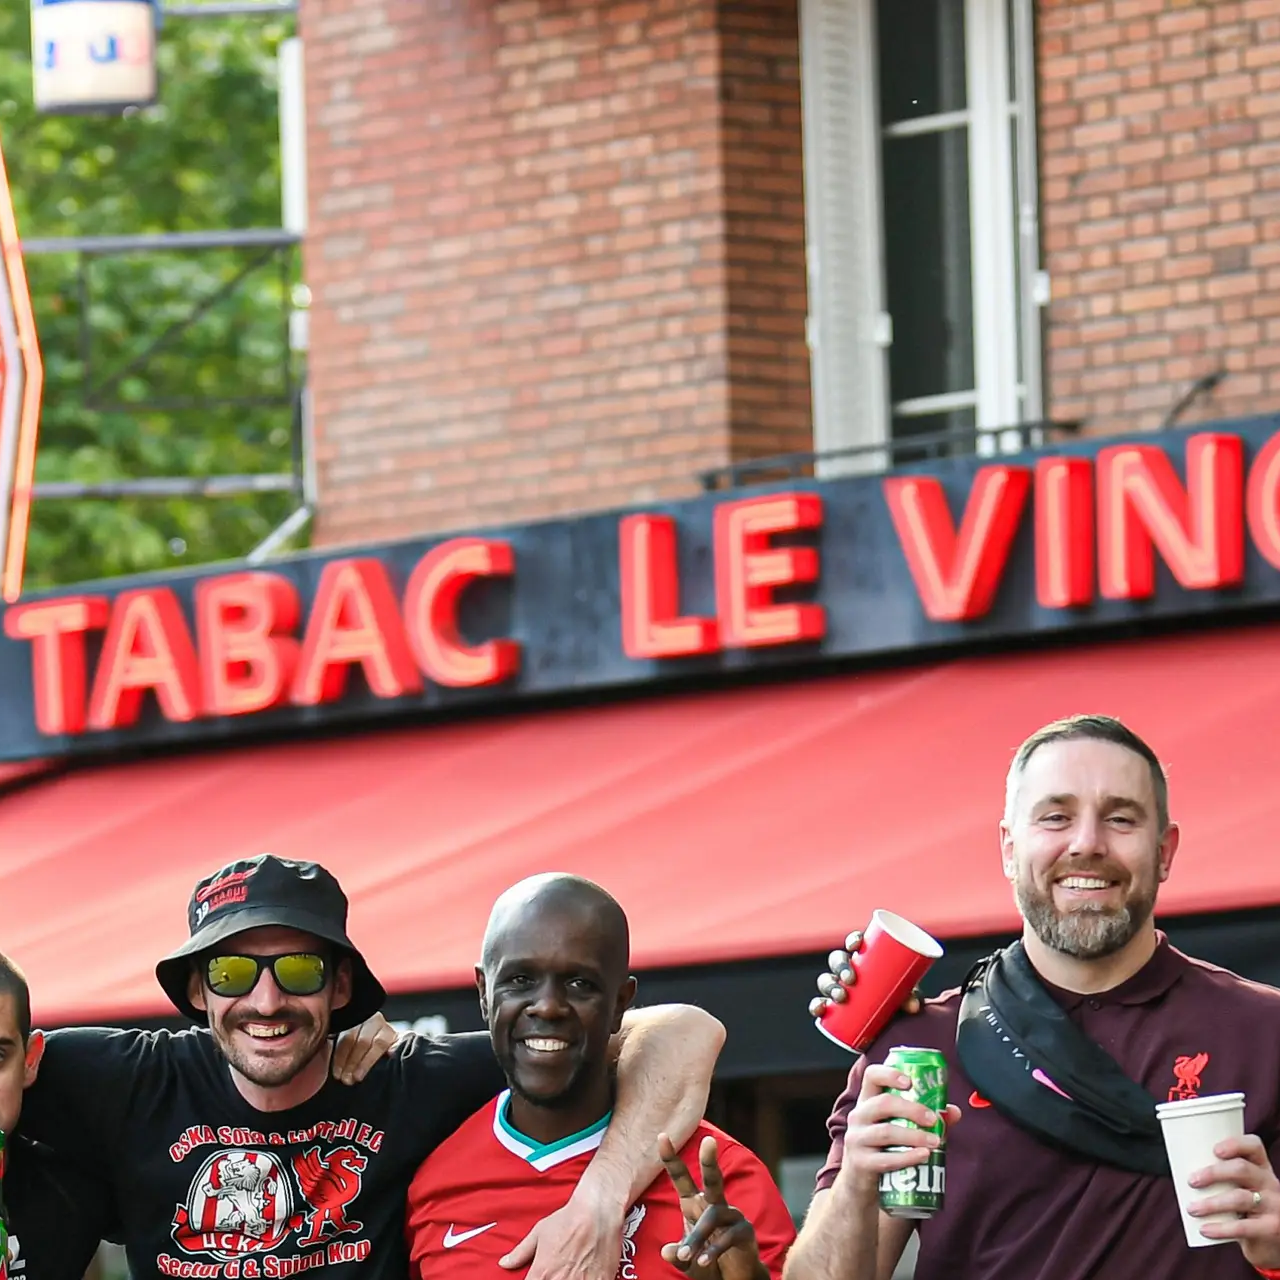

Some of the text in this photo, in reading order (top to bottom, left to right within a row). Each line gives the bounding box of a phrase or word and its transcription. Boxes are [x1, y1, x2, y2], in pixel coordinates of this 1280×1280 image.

[4, 537, 518, 736] TABAC
[619, 491, 826, 660] LE
[169, 1125, 218, 1162] CSKA
[157, 1239, 371, 1279] Sector G & Spion Kop
